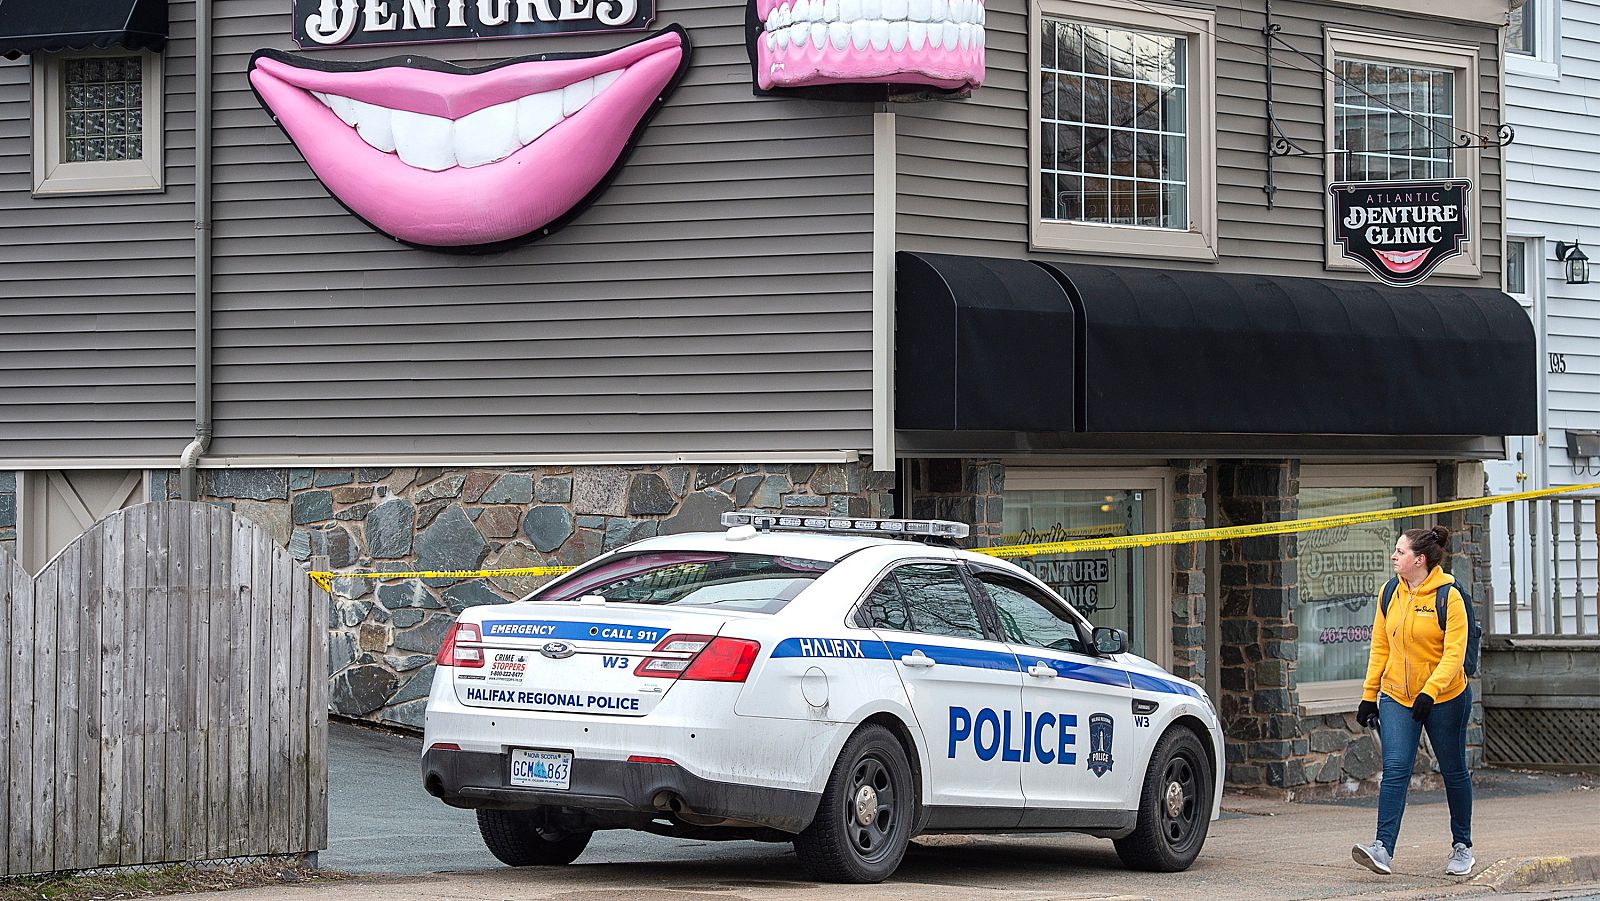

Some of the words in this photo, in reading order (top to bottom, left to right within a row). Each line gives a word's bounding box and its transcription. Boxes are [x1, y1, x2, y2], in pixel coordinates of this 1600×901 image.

[304, 0, 638, 45] DENTURES
[1366, 192, 1440, 204] ATLANTIC
[1344, 205, 1459, 229] DENTURE
[1365, 226, 1442, 244] CLINIC
[1549, 353, 1566, 373] 195
[1019, 558, 1109, 582] DENTURE
[1307, 550, 1385, 579] DENTURE
[1321, 573, 1376, 598] CLINIC
[490, 623, 556, 636] EMERGENCY
[601, 628, 633, 640] CALL
[637, 630, 658, 641] 911
[494, 653, 515, 662] CRIME
[546, 643, 563, 652] Ford
[799, 638, 865, 658] HALIFAX
[492, 662, 526, 672] STOPPERS
[602, 656, 629, 669] W3
[467, 687, 516, 703] HALIFAX
[517, 690, 583, 707] REGIONAL
[587, 694, 640, 710] POLICE
[1134, 715, 1150, 728] W3
[948, 705, 1078, 765] POLICE
[1092, 752, 1109, 763] POLICE
[513, 760, 534, 778] GCM
[547, 763, 569, 780] 863
